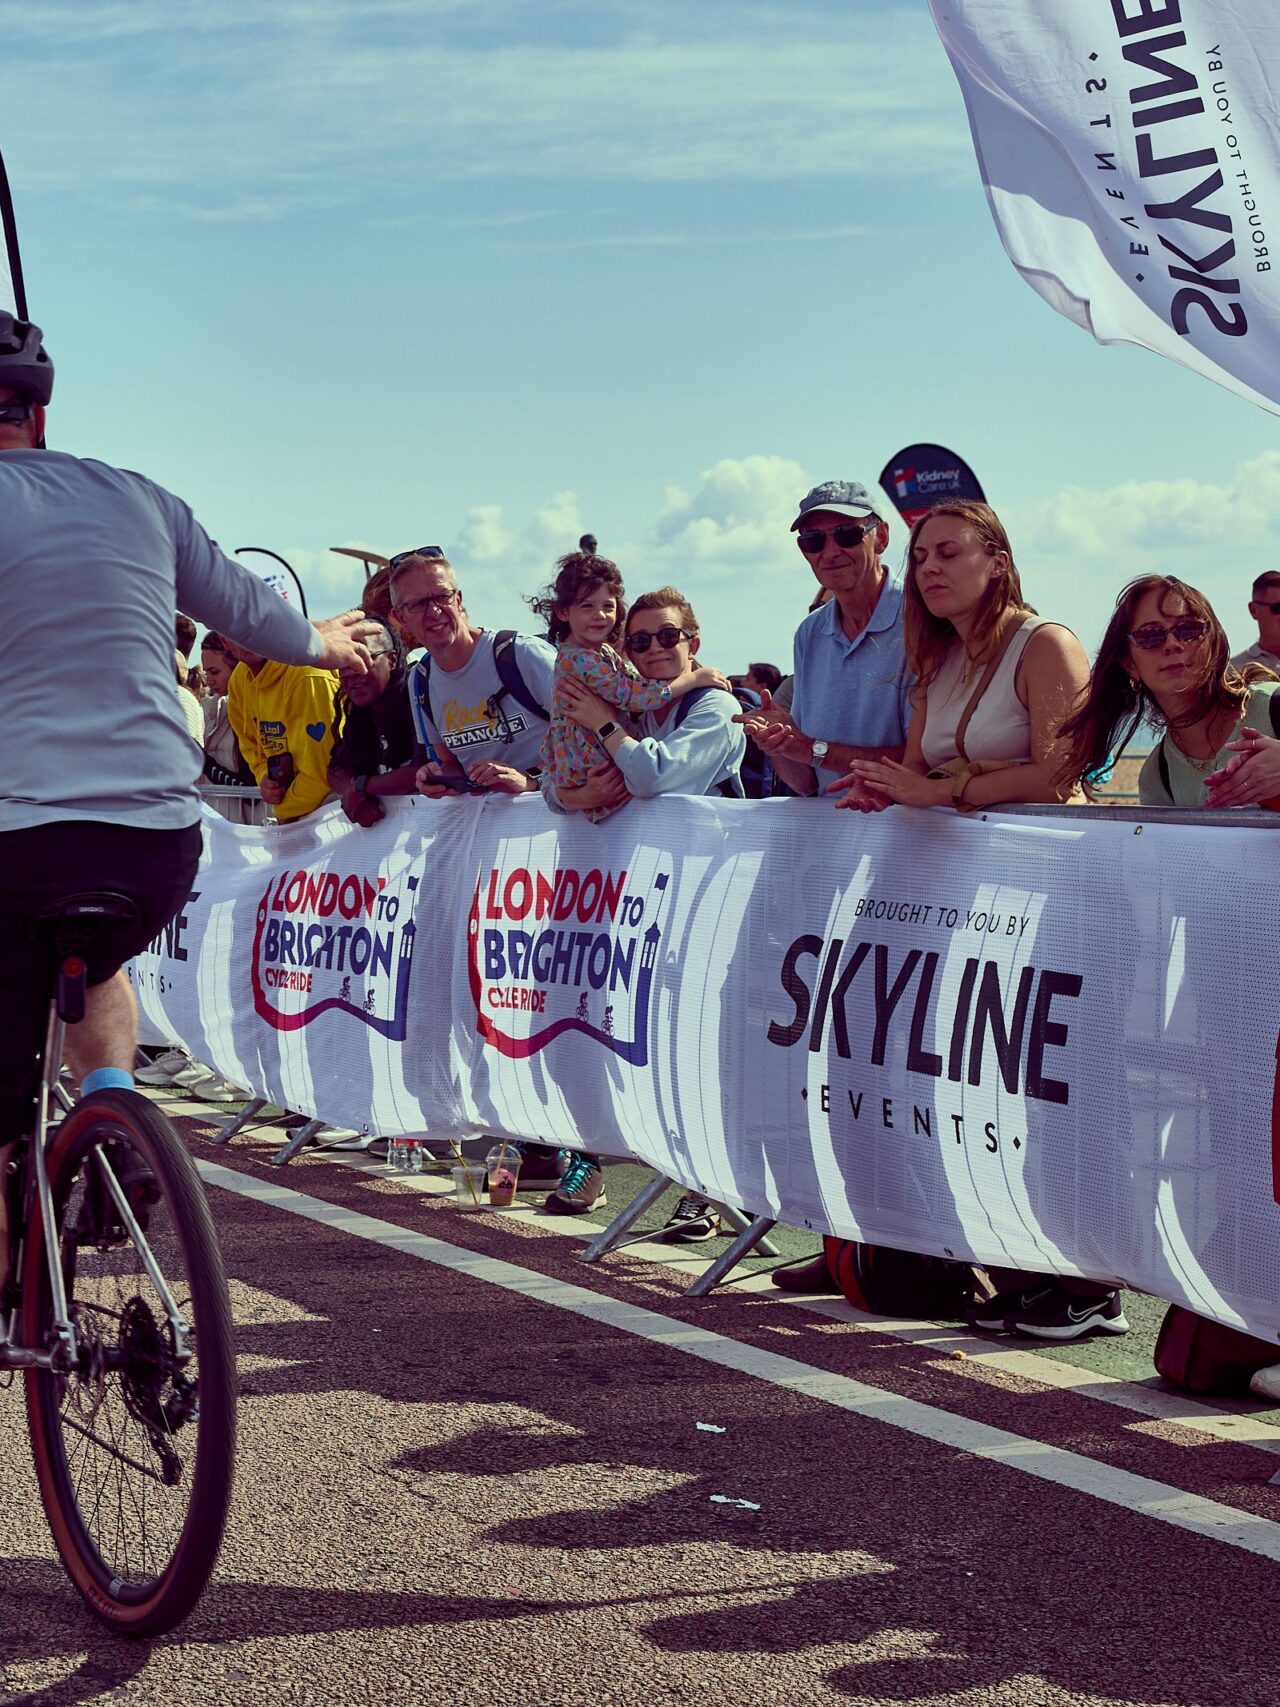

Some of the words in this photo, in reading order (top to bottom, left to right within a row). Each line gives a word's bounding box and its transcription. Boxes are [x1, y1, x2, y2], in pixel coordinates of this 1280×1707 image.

[916, 469, 960, 482] Kidney
[917, 482, 946, 494] Care
[272, 869, 386, 920] LONDON
[378, 895, 400, 922] TO
[486, 867, 627, 925] LONDON
[620, 895, 644, 927] TO
[854, 898, 933, 925] BROUGHT
[937, 907, 958, 928] TO
[965, 910, 1001, 933] YOU
[1006, 915, 1030, 937] BY
[264, 918, 394, 979] BRIGHTON
[484, 928, 637, 994] BRIGHTON
[127, 966, 165, 994] ENTS
[290, 970, 313, 993] RIDE
[520, 989, 547, 1013] RIDE
[767, 934, 1083, 1105] SKYLINE
[821, 1084, 999, 1154] EVENTS
